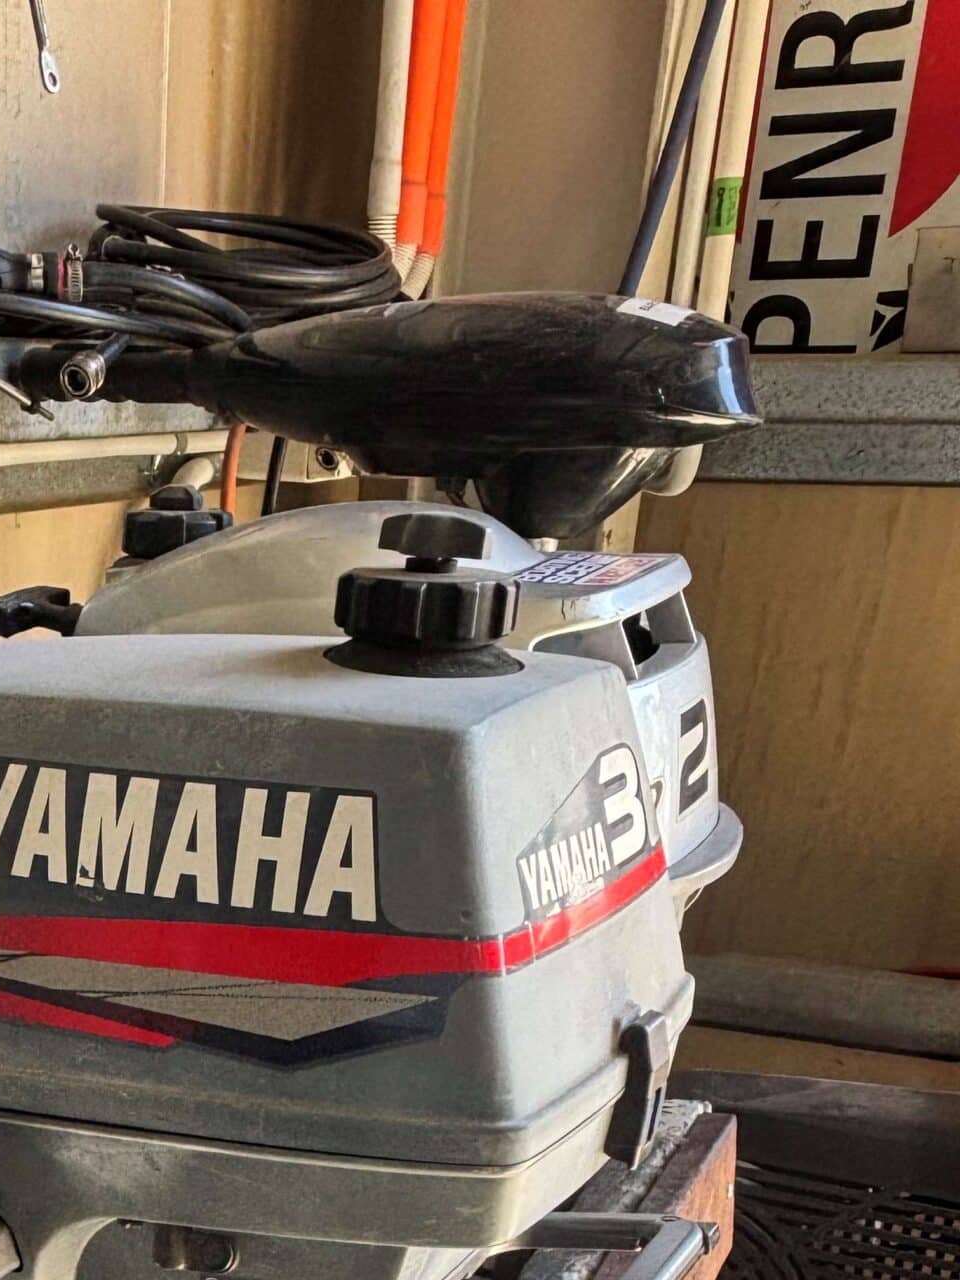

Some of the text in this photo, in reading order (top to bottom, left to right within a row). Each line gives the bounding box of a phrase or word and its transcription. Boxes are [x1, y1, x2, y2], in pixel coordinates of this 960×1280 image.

[678, 698, 709, 816] 2
[519, 747, 648, 910] YAMAHA 3
